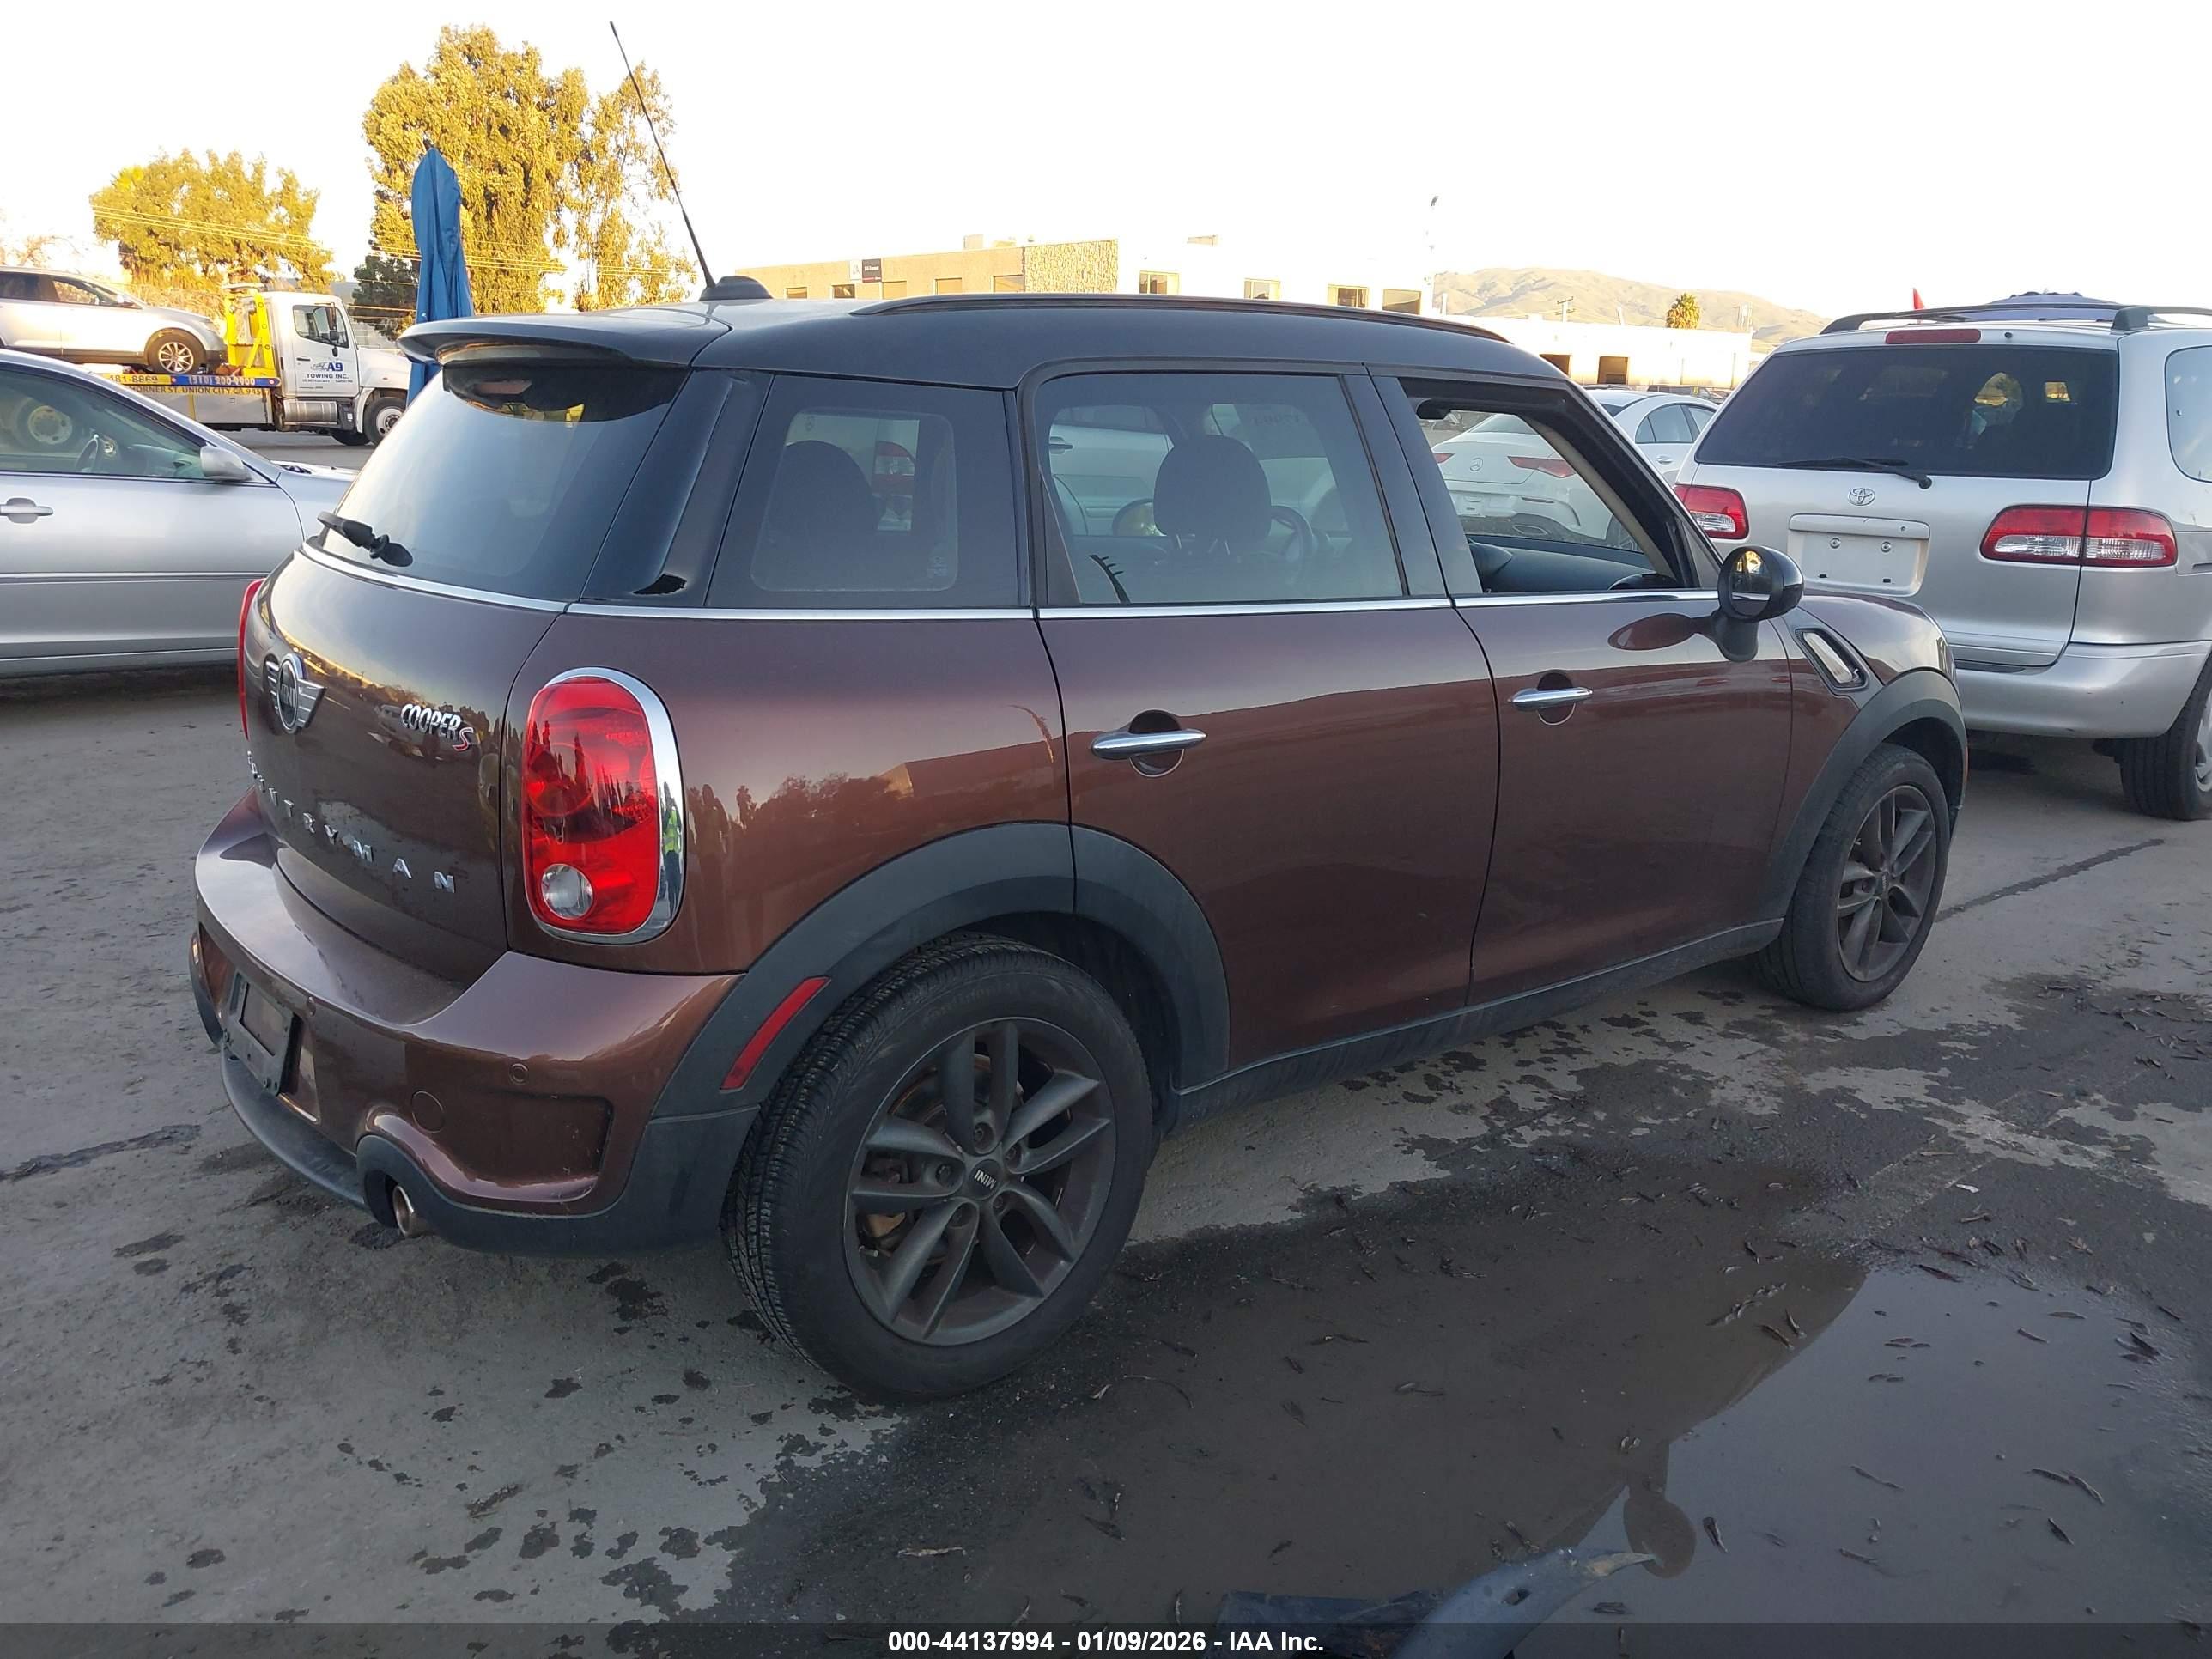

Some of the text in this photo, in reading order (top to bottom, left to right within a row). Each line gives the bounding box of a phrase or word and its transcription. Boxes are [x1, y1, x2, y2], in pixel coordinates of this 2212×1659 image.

[326, 362, 343, 372] A9
[401, 703, 475, 752] COOPER S
[974, 1169, 997, 1190] MINI
